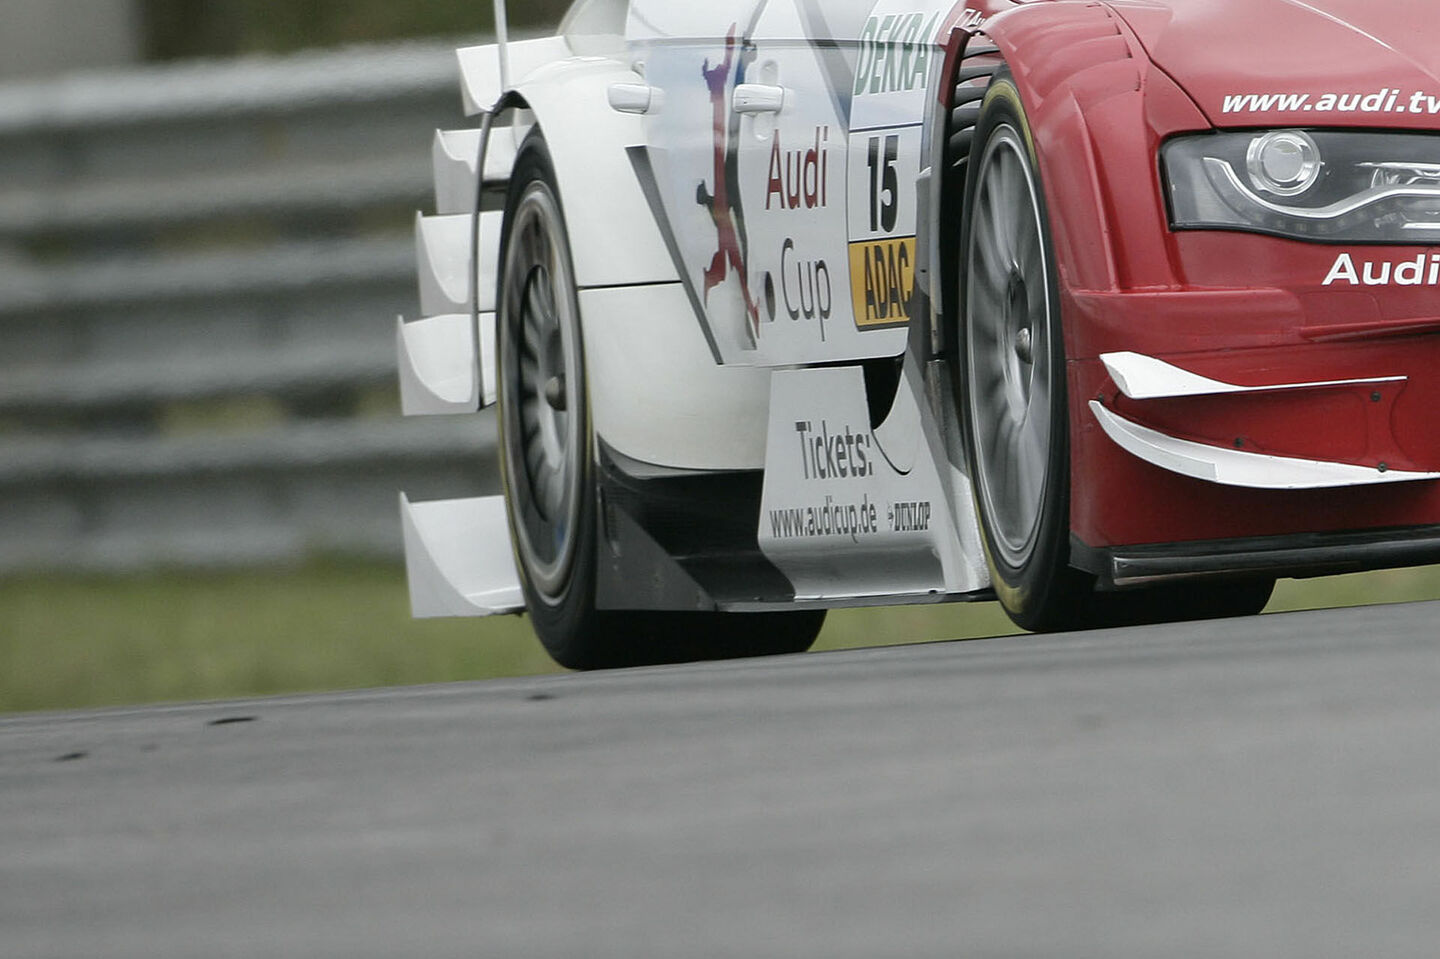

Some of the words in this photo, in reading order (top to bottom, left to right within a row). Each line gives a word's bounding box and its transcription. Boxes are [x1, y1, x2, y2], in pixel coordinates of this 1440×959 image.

[854, 11, 940, 96] DEKRA
[765, 125, 829, 210] Audi
[867, 134, 899, 232] 15
[780, 237, 831, 342] Cup
[864, 241, 913, 321] ADAC
[795, 419, 873, 480] Tickets:
[769, 493, 877, 544] www.audicup.de
